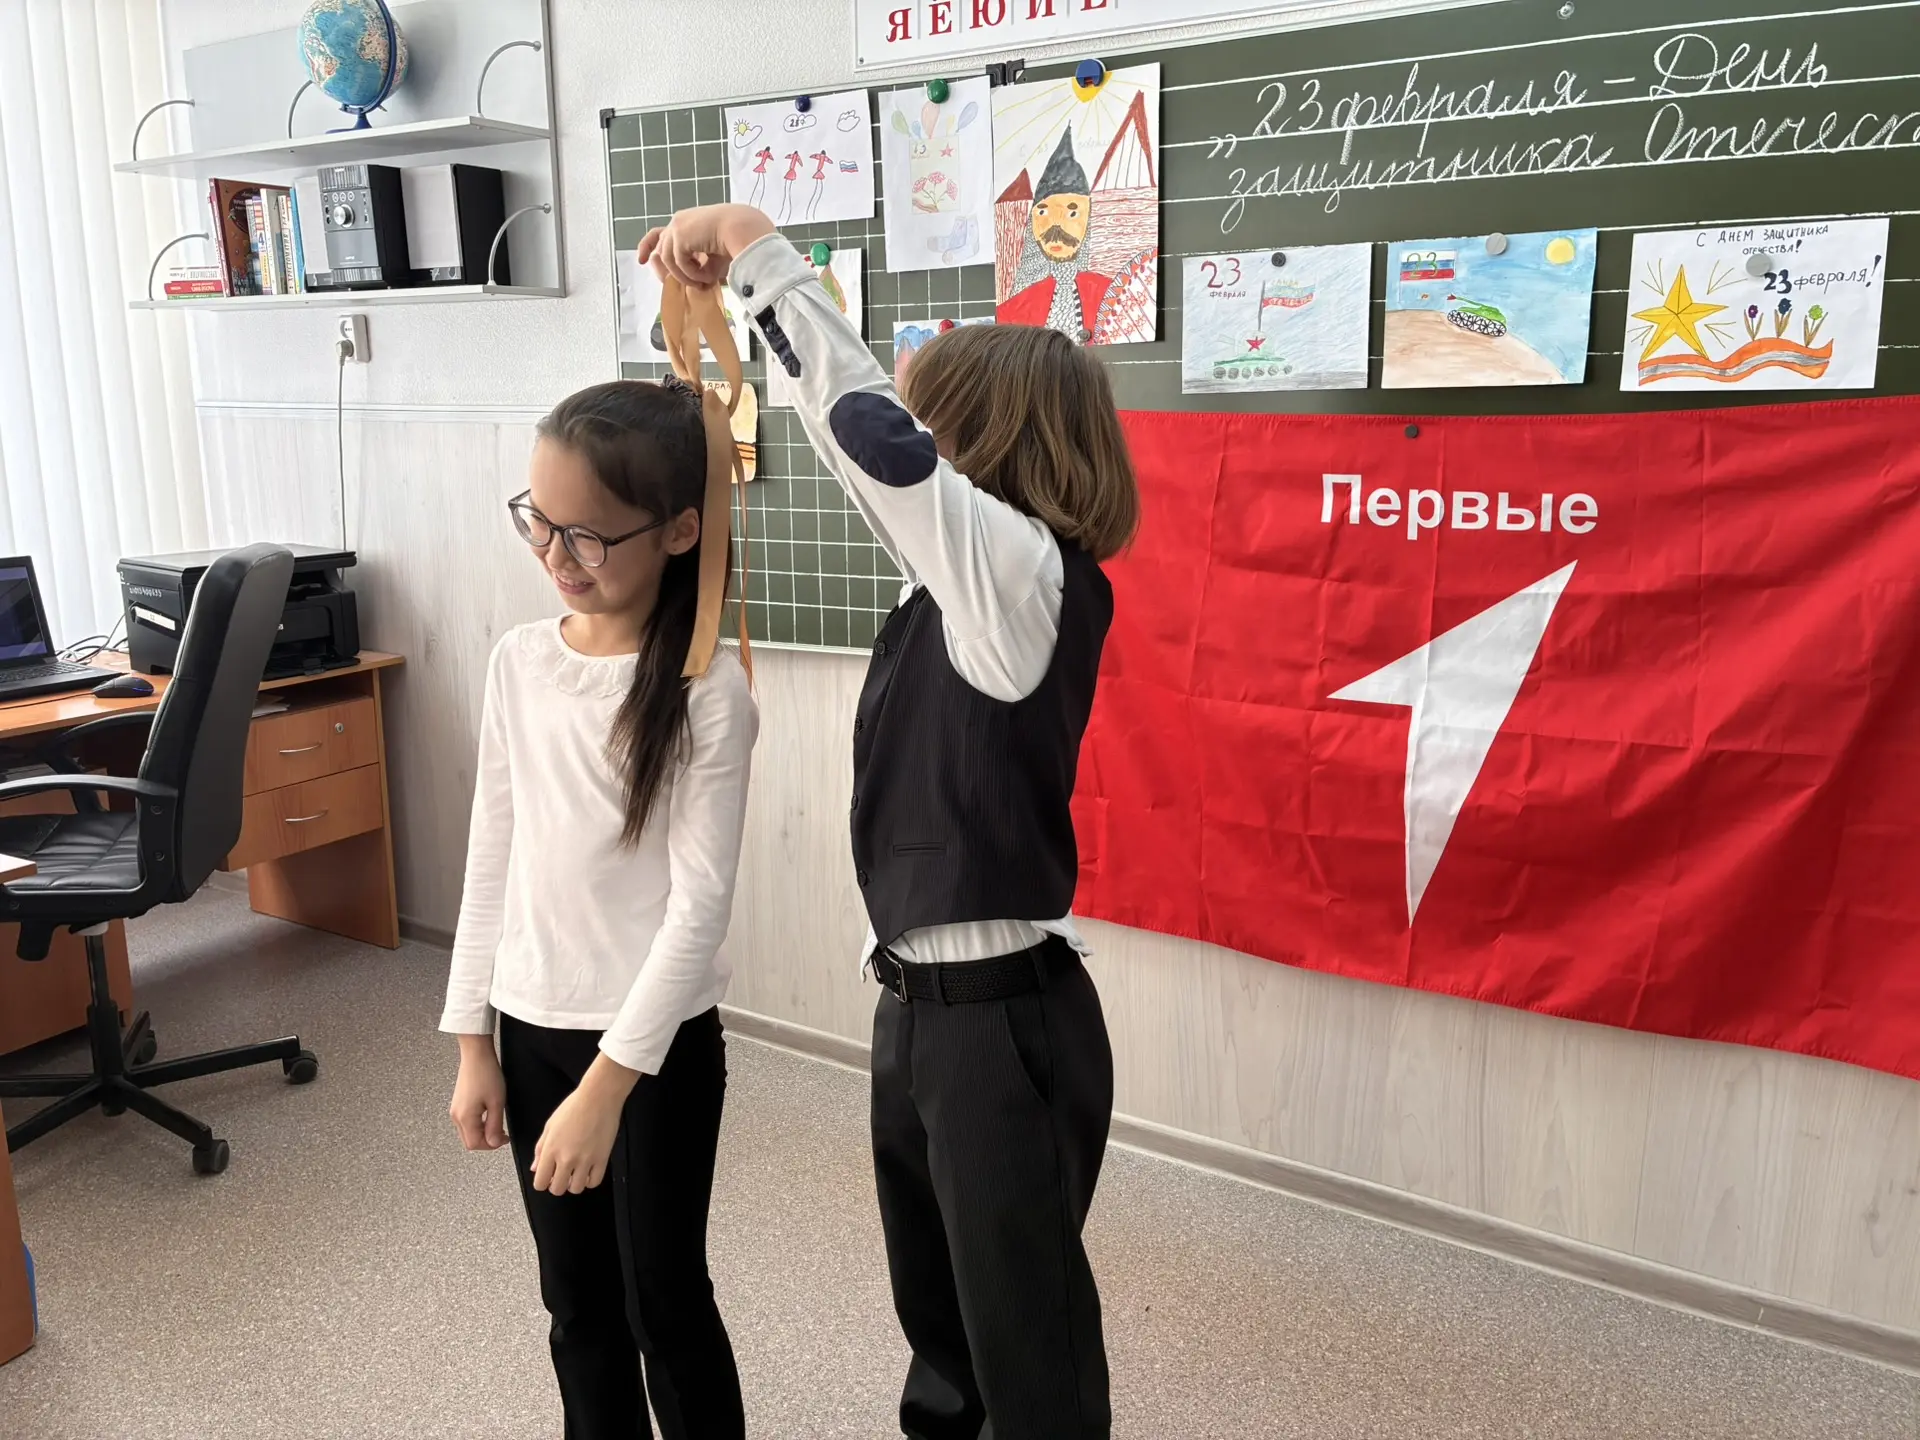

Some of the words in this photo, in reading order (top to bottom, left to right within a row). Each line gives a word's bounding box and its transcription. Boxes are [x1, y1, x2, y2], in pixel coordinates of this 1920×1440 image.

[886, 7, 912, 42] Я
[969, 0, 1006, 29] Ю
[1650, 33, 1828, 100] День
[1220, 128, 1614, 234] защитника
[1696, 232, 1707, 247] С
[1717, 229, 1754, 243] ДНЕМ
[1763, 225, 1828, 241] ЗАЩИТНИКА
[1200, 257, 1241, 289] 23
[1407, 251, 1438, 279] 23
[1764, 268, 1793, 294] 23
[1320, 473, 1599, 541] Первые
